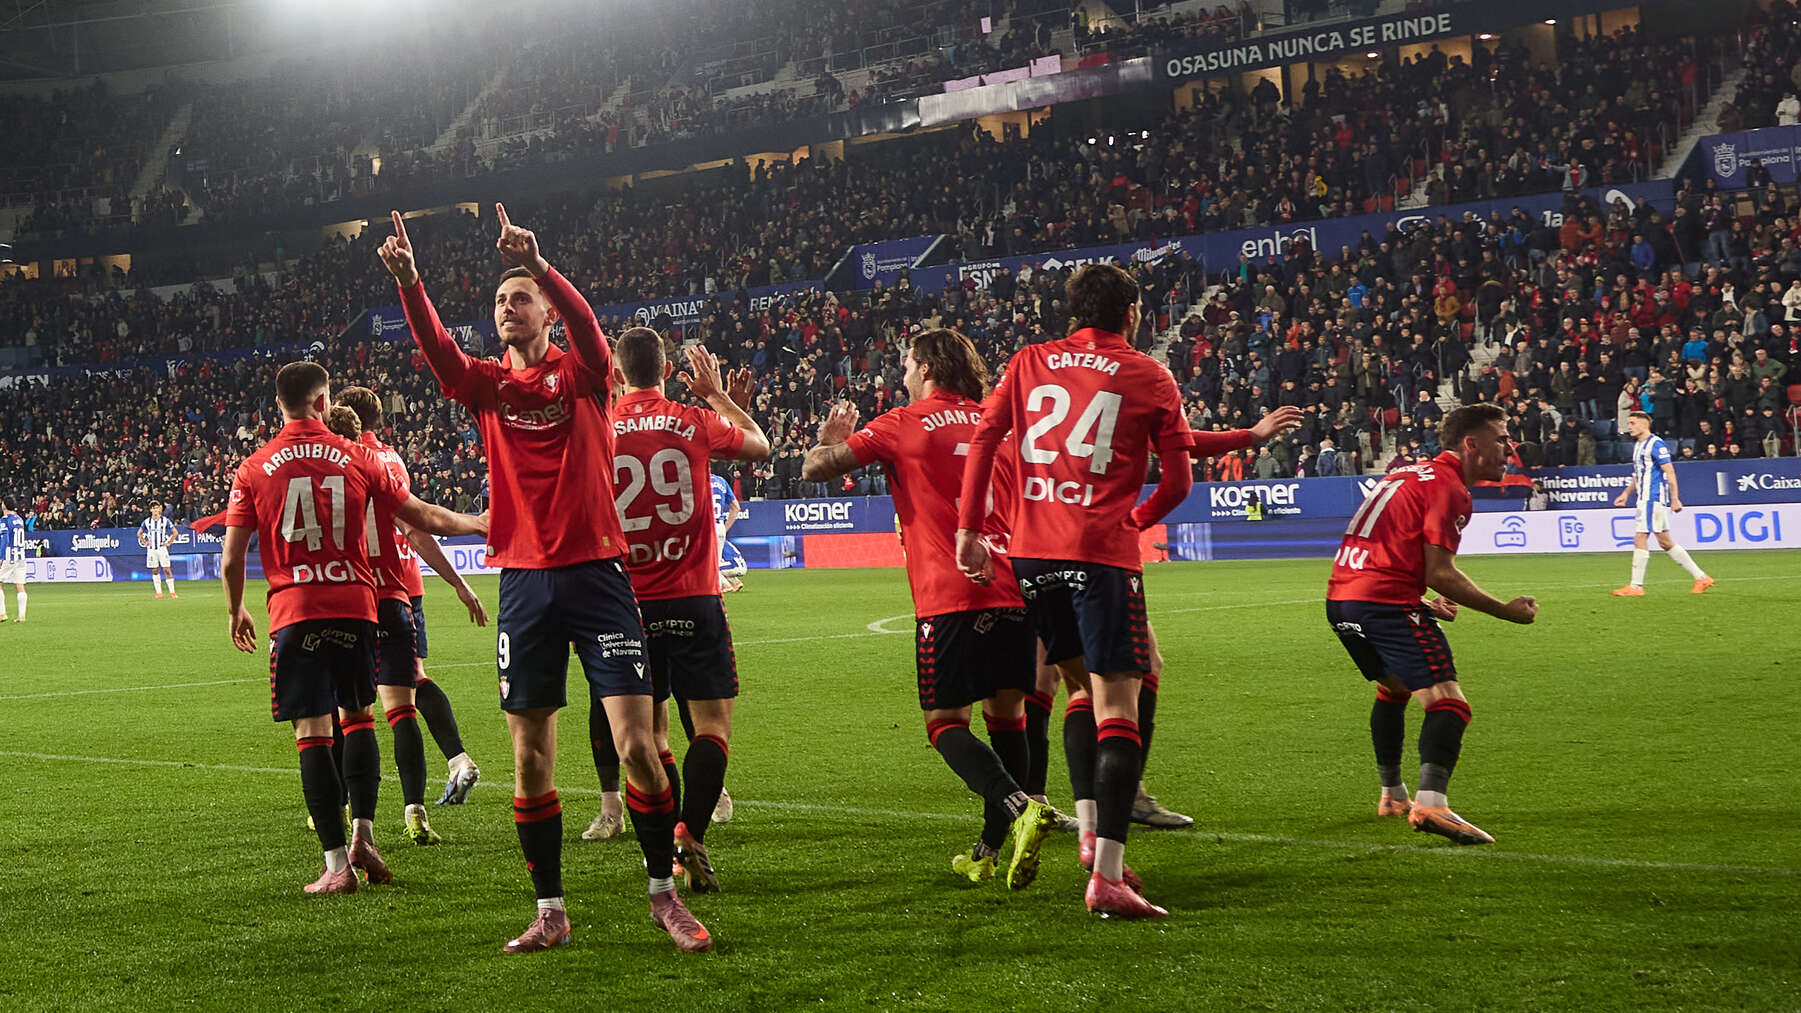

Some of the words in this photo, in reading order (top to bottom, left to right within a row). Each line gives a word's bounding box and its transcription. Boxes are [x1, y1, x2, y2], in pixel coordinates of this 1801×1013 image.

[1167, 44, 1263, 77] OSASUNA
[1269, 31, 1345, 60] NUNCA
[1350, 25, 1376, 48] SE
[1381, 13, 1452, 42] RINDE
[1739, 155, 1790, 168] Paplona
[1047, 352, 1121, 377] CATENA
[613, 415, 696, 441] SAMBELA
[921, 409, 969, 432] JUAN
[1020, 384, 1123, 475] 24
[262, 443, 352, 477] ARGUIBIDE
[613, 448, 695, 532] 29
[1023, 477, 1093, 506] DIGI
[1549, 491, 1608, 502] Navarra
[281, 475, 345, 552] 41
[1345, 479, 1405, 538] 11
[13, 528, 25, 547] 10
[1565, 522, 1585, 534] 5G
[1694, 511, 1782, 543] DIGI
[292, 559, 357, 584] DIGI
[454, 549, 493, 569] DIG
[1036, 570, 1087, 584] CRYPTO
[498, 631, 510, 670] 9
